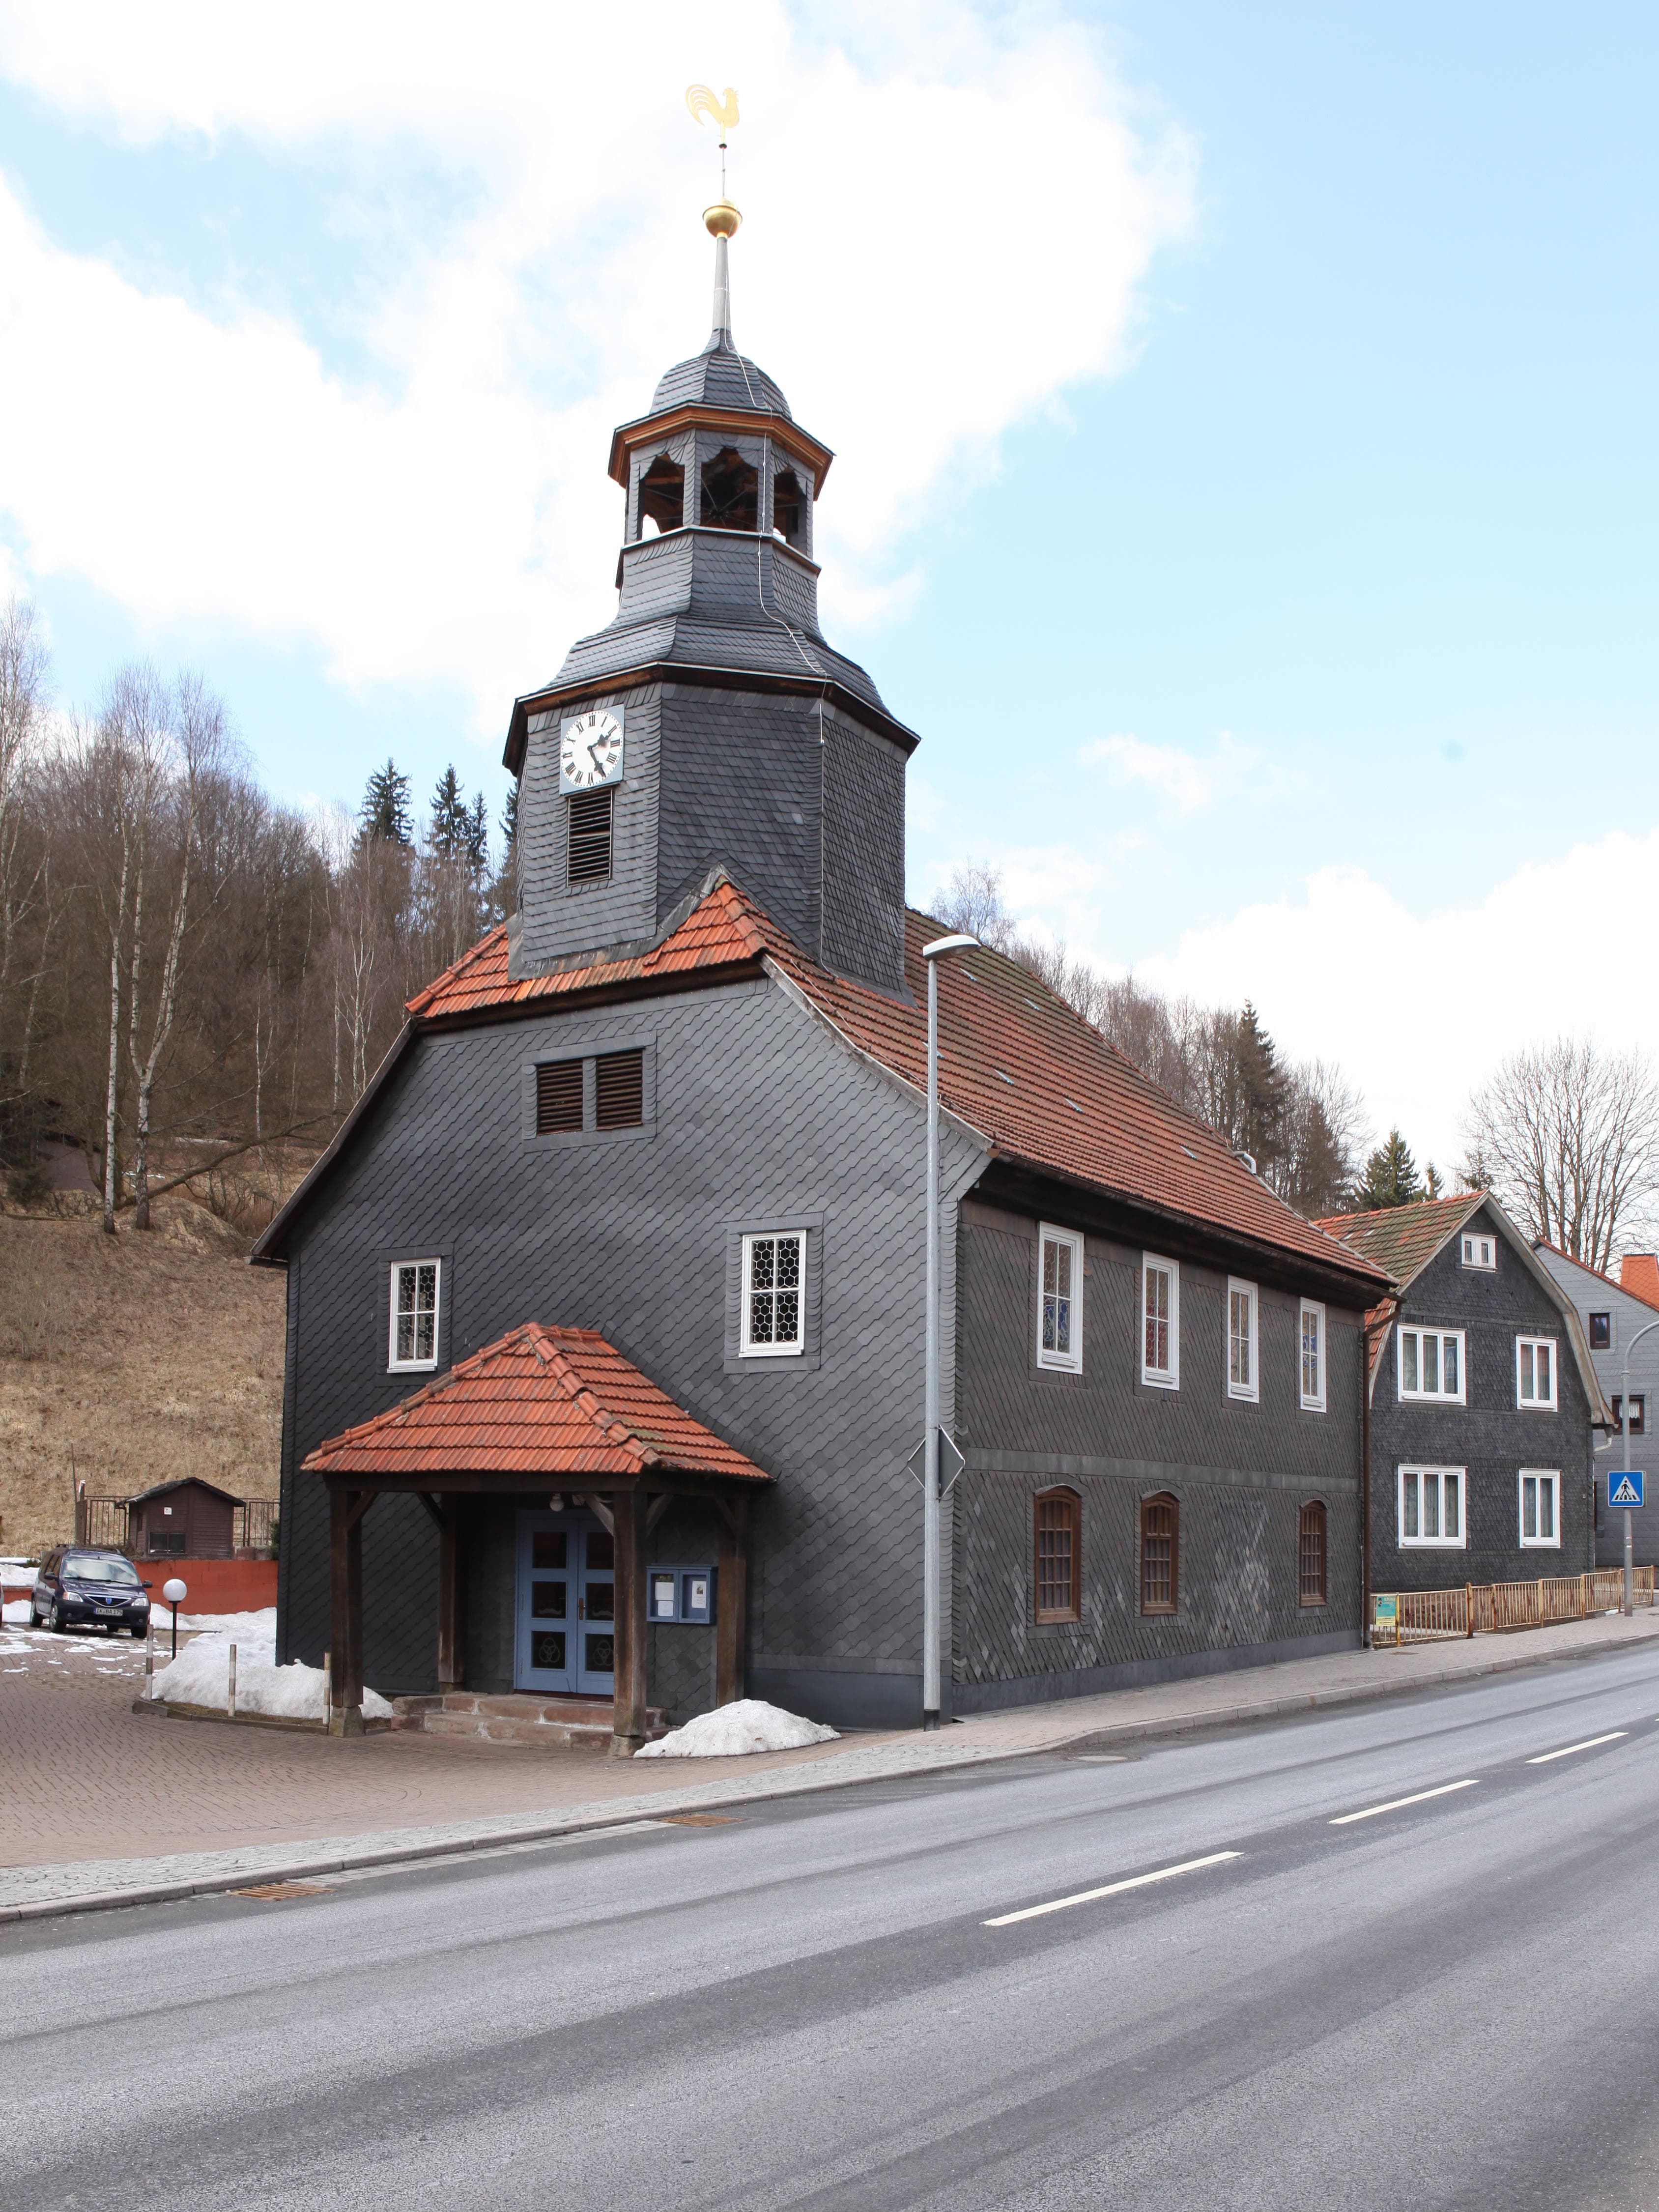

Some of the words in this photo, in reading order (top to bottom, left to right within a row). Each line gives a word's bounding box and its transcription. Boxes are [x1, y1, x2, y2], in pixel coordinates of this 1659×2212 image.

[601, 716, 608, 727] I
[576, 721, 584, 735] XI
[610, 739, 620, 747] III
